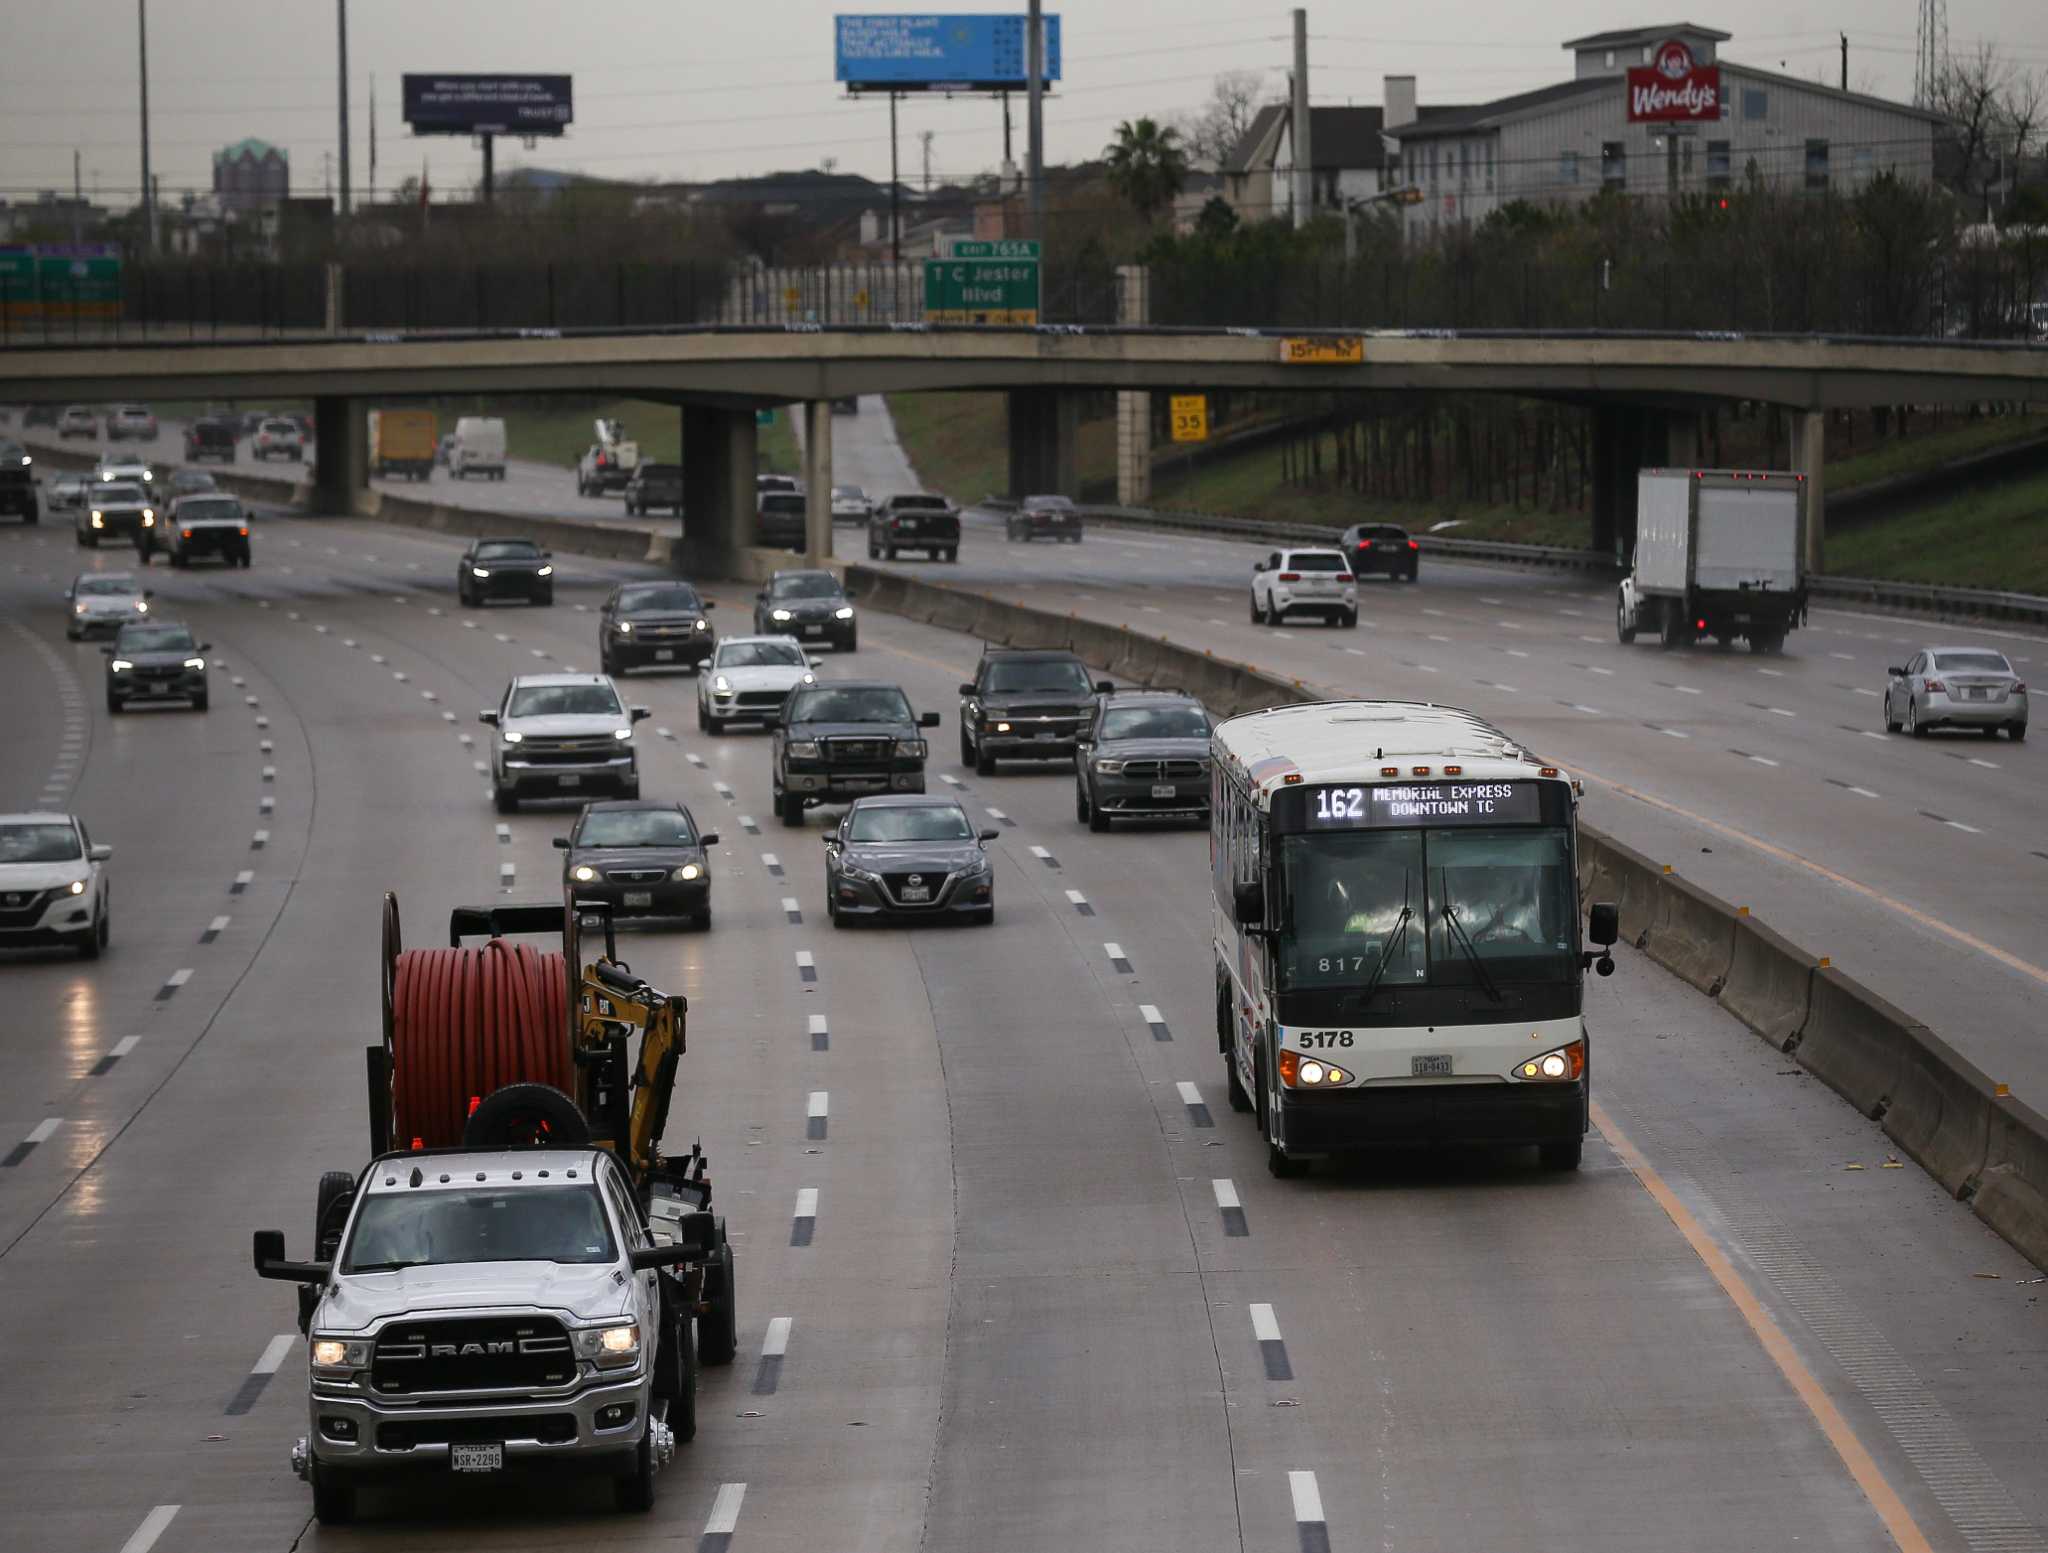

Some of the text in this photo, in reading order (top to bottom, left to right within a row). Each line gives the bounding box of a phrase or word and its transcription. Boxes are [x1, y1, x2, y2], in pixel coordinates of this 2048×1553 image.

[1633, 78, 1716, 115] Wendy's
[975, 266, 1030, 282] Jester
[1176, 414, 1200, 429] 35
[1317, 784, 1512, 818] 162 MEMORIAL EXPRESS
[1391, 800, 1495, 816] DOWNTOWN TC
[1299, 1030, 1354, 1048] 5178
[432, 1342, 513, 1357] RAM
